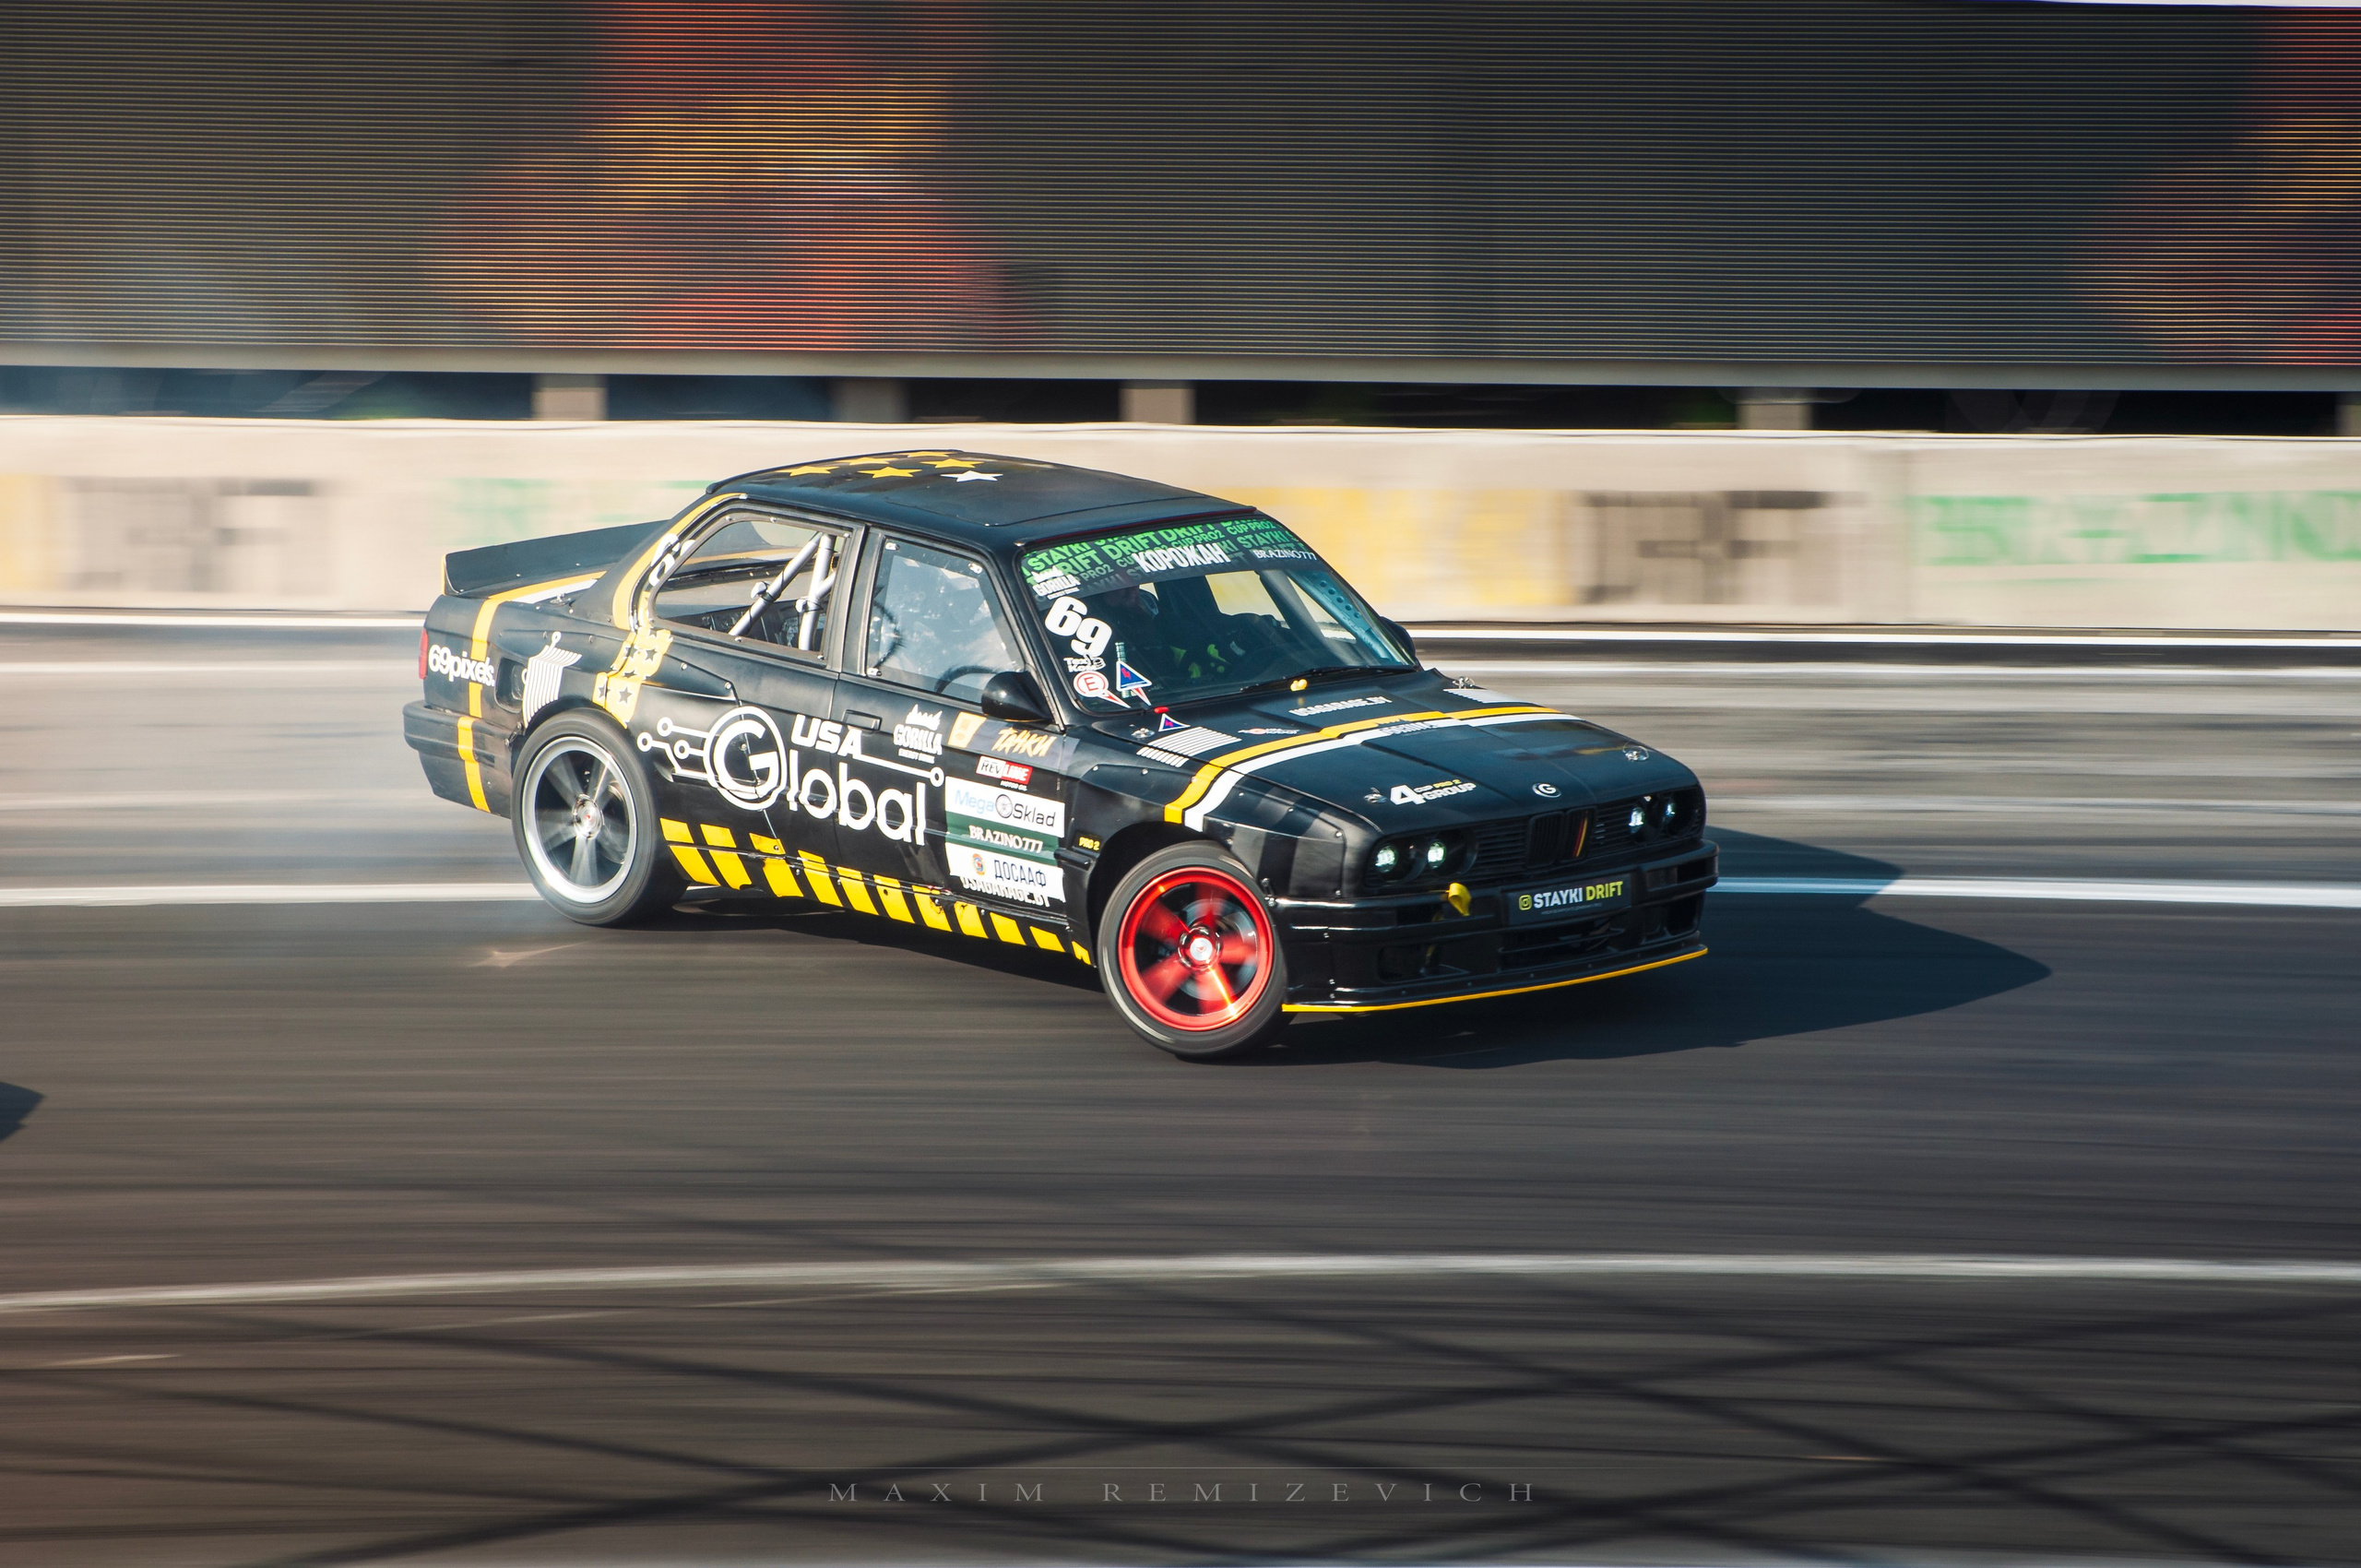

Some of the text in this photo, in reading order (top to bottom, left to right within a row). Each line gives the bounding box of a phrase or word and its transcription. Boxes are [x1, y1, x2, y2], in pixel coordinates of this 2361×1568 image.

[1100, 530, 1162, 560] DRIFT
[1192, 529, 1226, 545] PRO2
[1236, 530, 1290, 549] STAYKI
[1027, 541, 1092, 571] STAYKI
[1132, 542, 1231, 573] КОРОЖАН
[1252, 548, 1317, 561] BRAZINO777
[1033, 574, 1081, 597] GORILLA
[1080, 564, 1115, 581] PRO2
[1044, 596, 1112, 658] 69
[1083, 676, 1099, 692] E
[790, 713, 863, 759] USA
[893, 723, 943, 755] GORILLA
[714, 719, 927, 847] Global
[1390, 782, 1477, 805] 4 GROUP
[955, 790, 1056, 827] Mega Sklad
[968, 825, 1043, 854] BRAZINO777
[994, 860, 1047, 887] ДОСААФ
[1534, 887, 1583, 909] STAYKI
[1586, 881, 1623, 901] DRIFT
